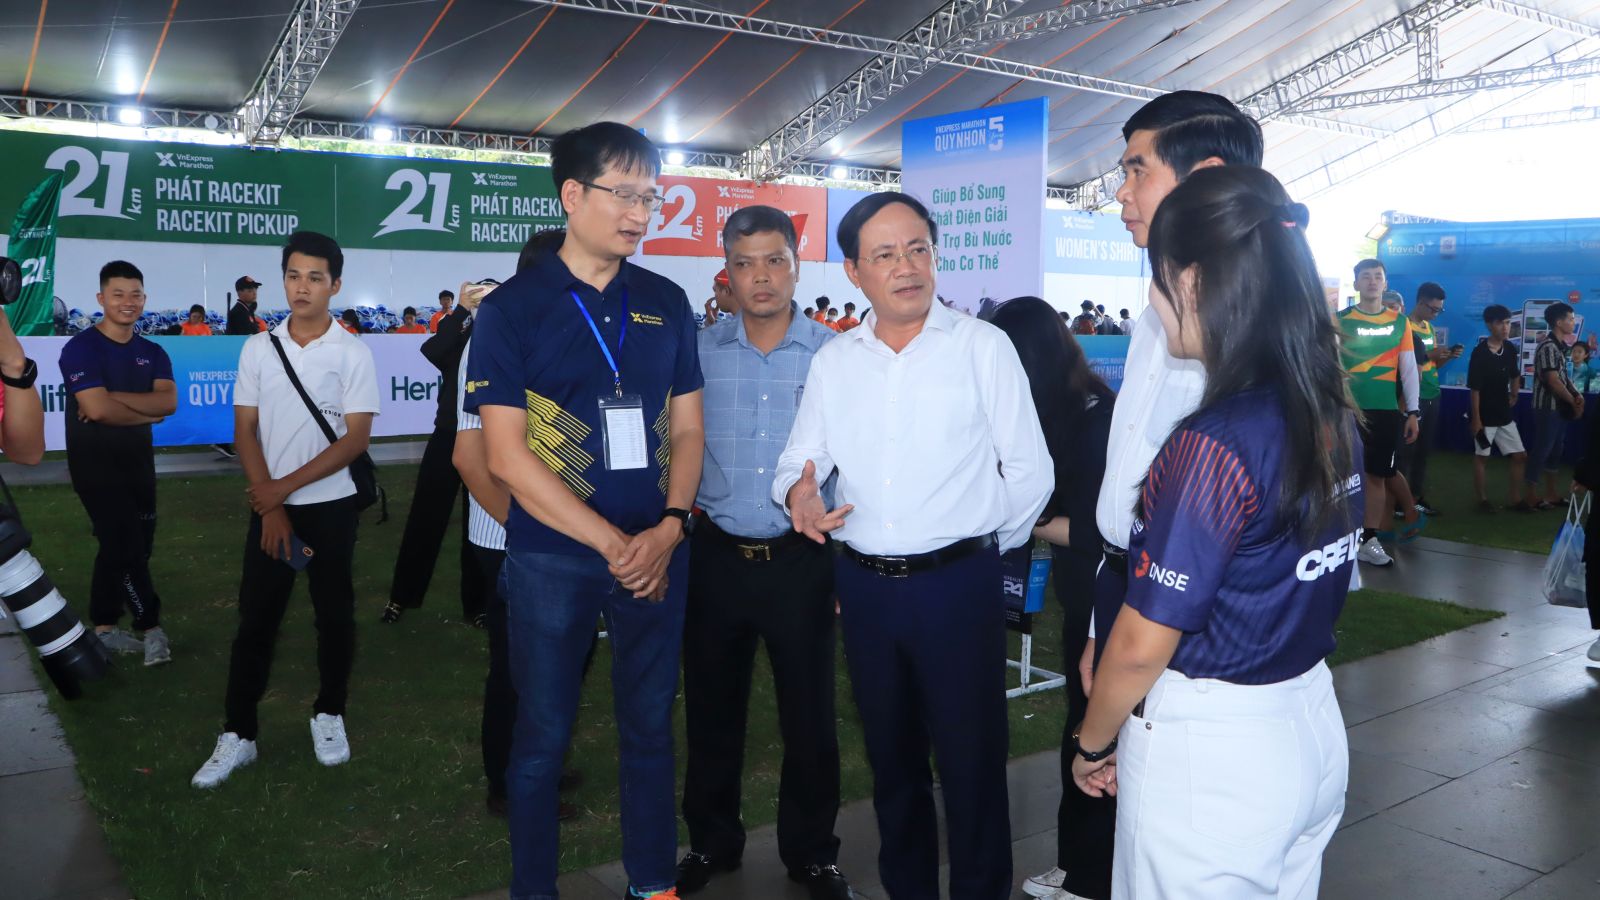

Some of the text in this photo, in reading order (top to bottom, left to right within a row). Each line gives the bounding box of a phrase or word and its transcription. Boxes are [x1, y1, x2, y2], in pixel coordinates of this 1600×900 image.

[961, 119, 987, 130] MARATHON
[935, 129, 986, 152] QUYNHON
[176, 153, 214, 162] VnExpress
[179, 161, 214, 169] Marathon
[44, 145, 130, 218] 21
[488, 173, 517, 181] VnExpress
[127, 188, 142, 214] km
[155, 175, 282, 205] PHÁT RACEKIT
[379, 168, 452, 233] 21
[730, 186, 755, 194] VnExpress
[731, 192, 755, 200] Marathon
[932, 182, 1006, 206] Giúp Bổ Sung
[448, 204, 460, 228] km
[471, 192, 562, 217] PHÁT RACEKI
[156, 208, 299, 235] RACEKIT PICKUP
[693, 215, 704, 237] km
[956, 208, 981, 227] Điện
[471, 222, 532, 243] RACEKIT
[943, 228, 1013, 251] Trợ Bù Nước
[937, 251, 1000, 272] Cho Cơ Thể
[1055, 237, 1139, 262] WOMEN'S SHIRT
[21, 255, 47, 288] 21
[40, 383, 67, 412] lif
[189, 383, 231, 407] QUY
[1149, 561, 1190, 592] DNSE
